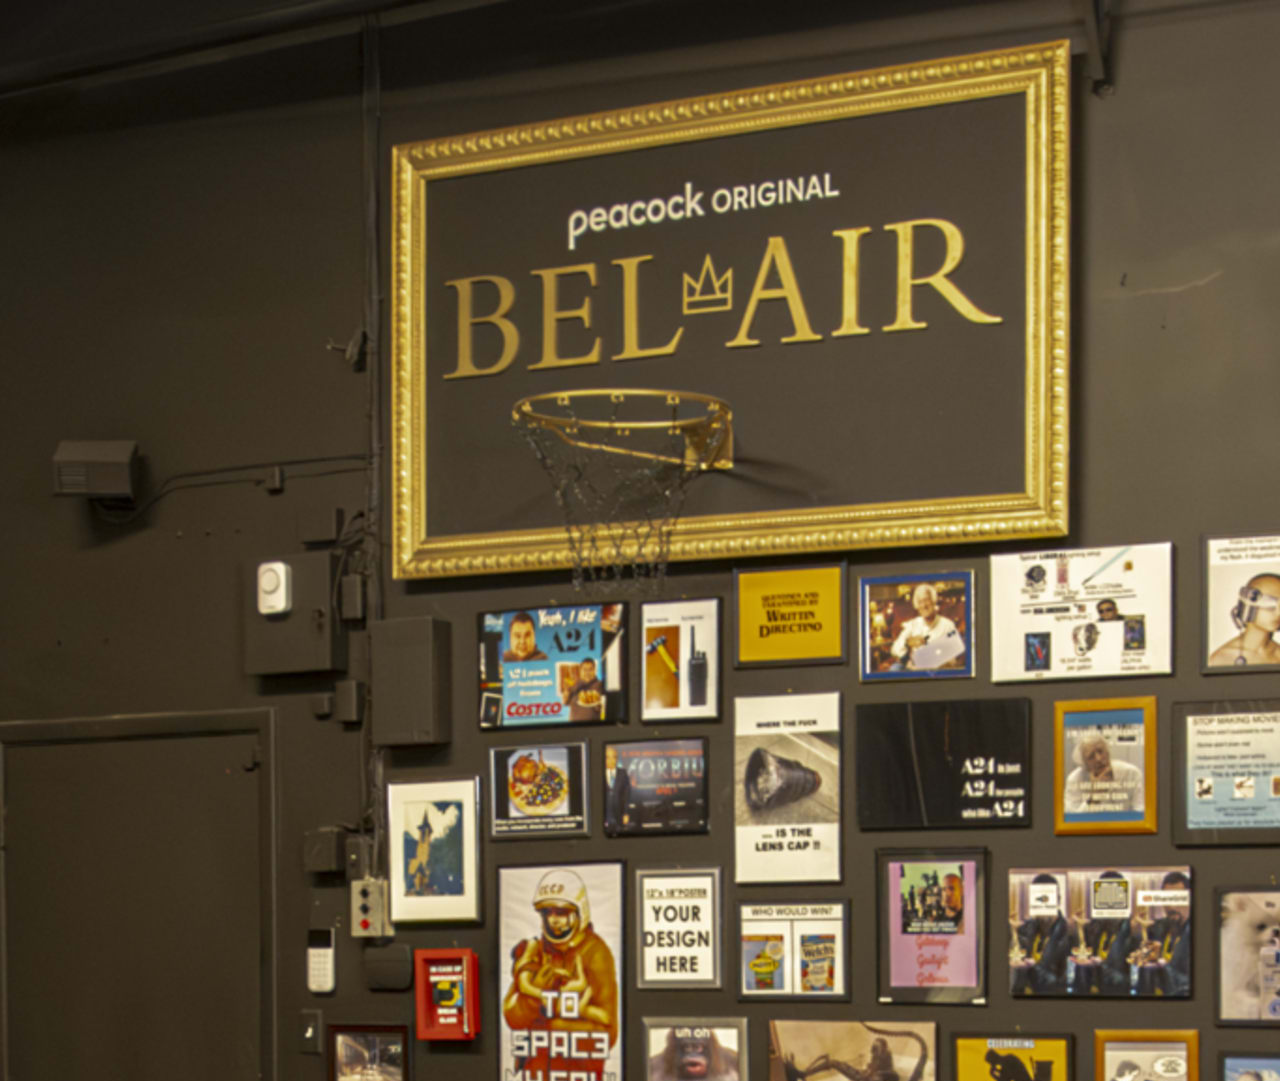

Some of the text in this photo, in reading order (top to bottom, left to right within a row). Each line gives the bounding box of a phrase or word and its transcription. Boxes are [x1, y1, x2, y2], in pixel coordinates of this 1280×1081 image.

[567, 172, 840, 250] peacock ORIGINAL
[442, 217, 1004, 381] BEL AIR
[549, 627, 596, 654] A24
[505, 701, 563, 718] COSTCO
[756, 718, 817, 729] WHERE THE FUCK
[961, 757, 995, 775] A24
[961, 780, 995, 797] A24
[992, 800, 1024, 818] A24
[775, 827, 787, 838] IS
[790, 827, 813, 838] THE
[755, 841, 784, 852] LENS
[787, 841, 810, 851] CAP
[652, 905, 702, 922] YOUR
[751, 906, 833, 916] WHO WOULD WIN?
[643, 930, 710, 948] DESIGN
[656, 955, 699, 973] HERE
[540, 990, 580, 1018] TO
[693, 1027, 711, 1038] oh
